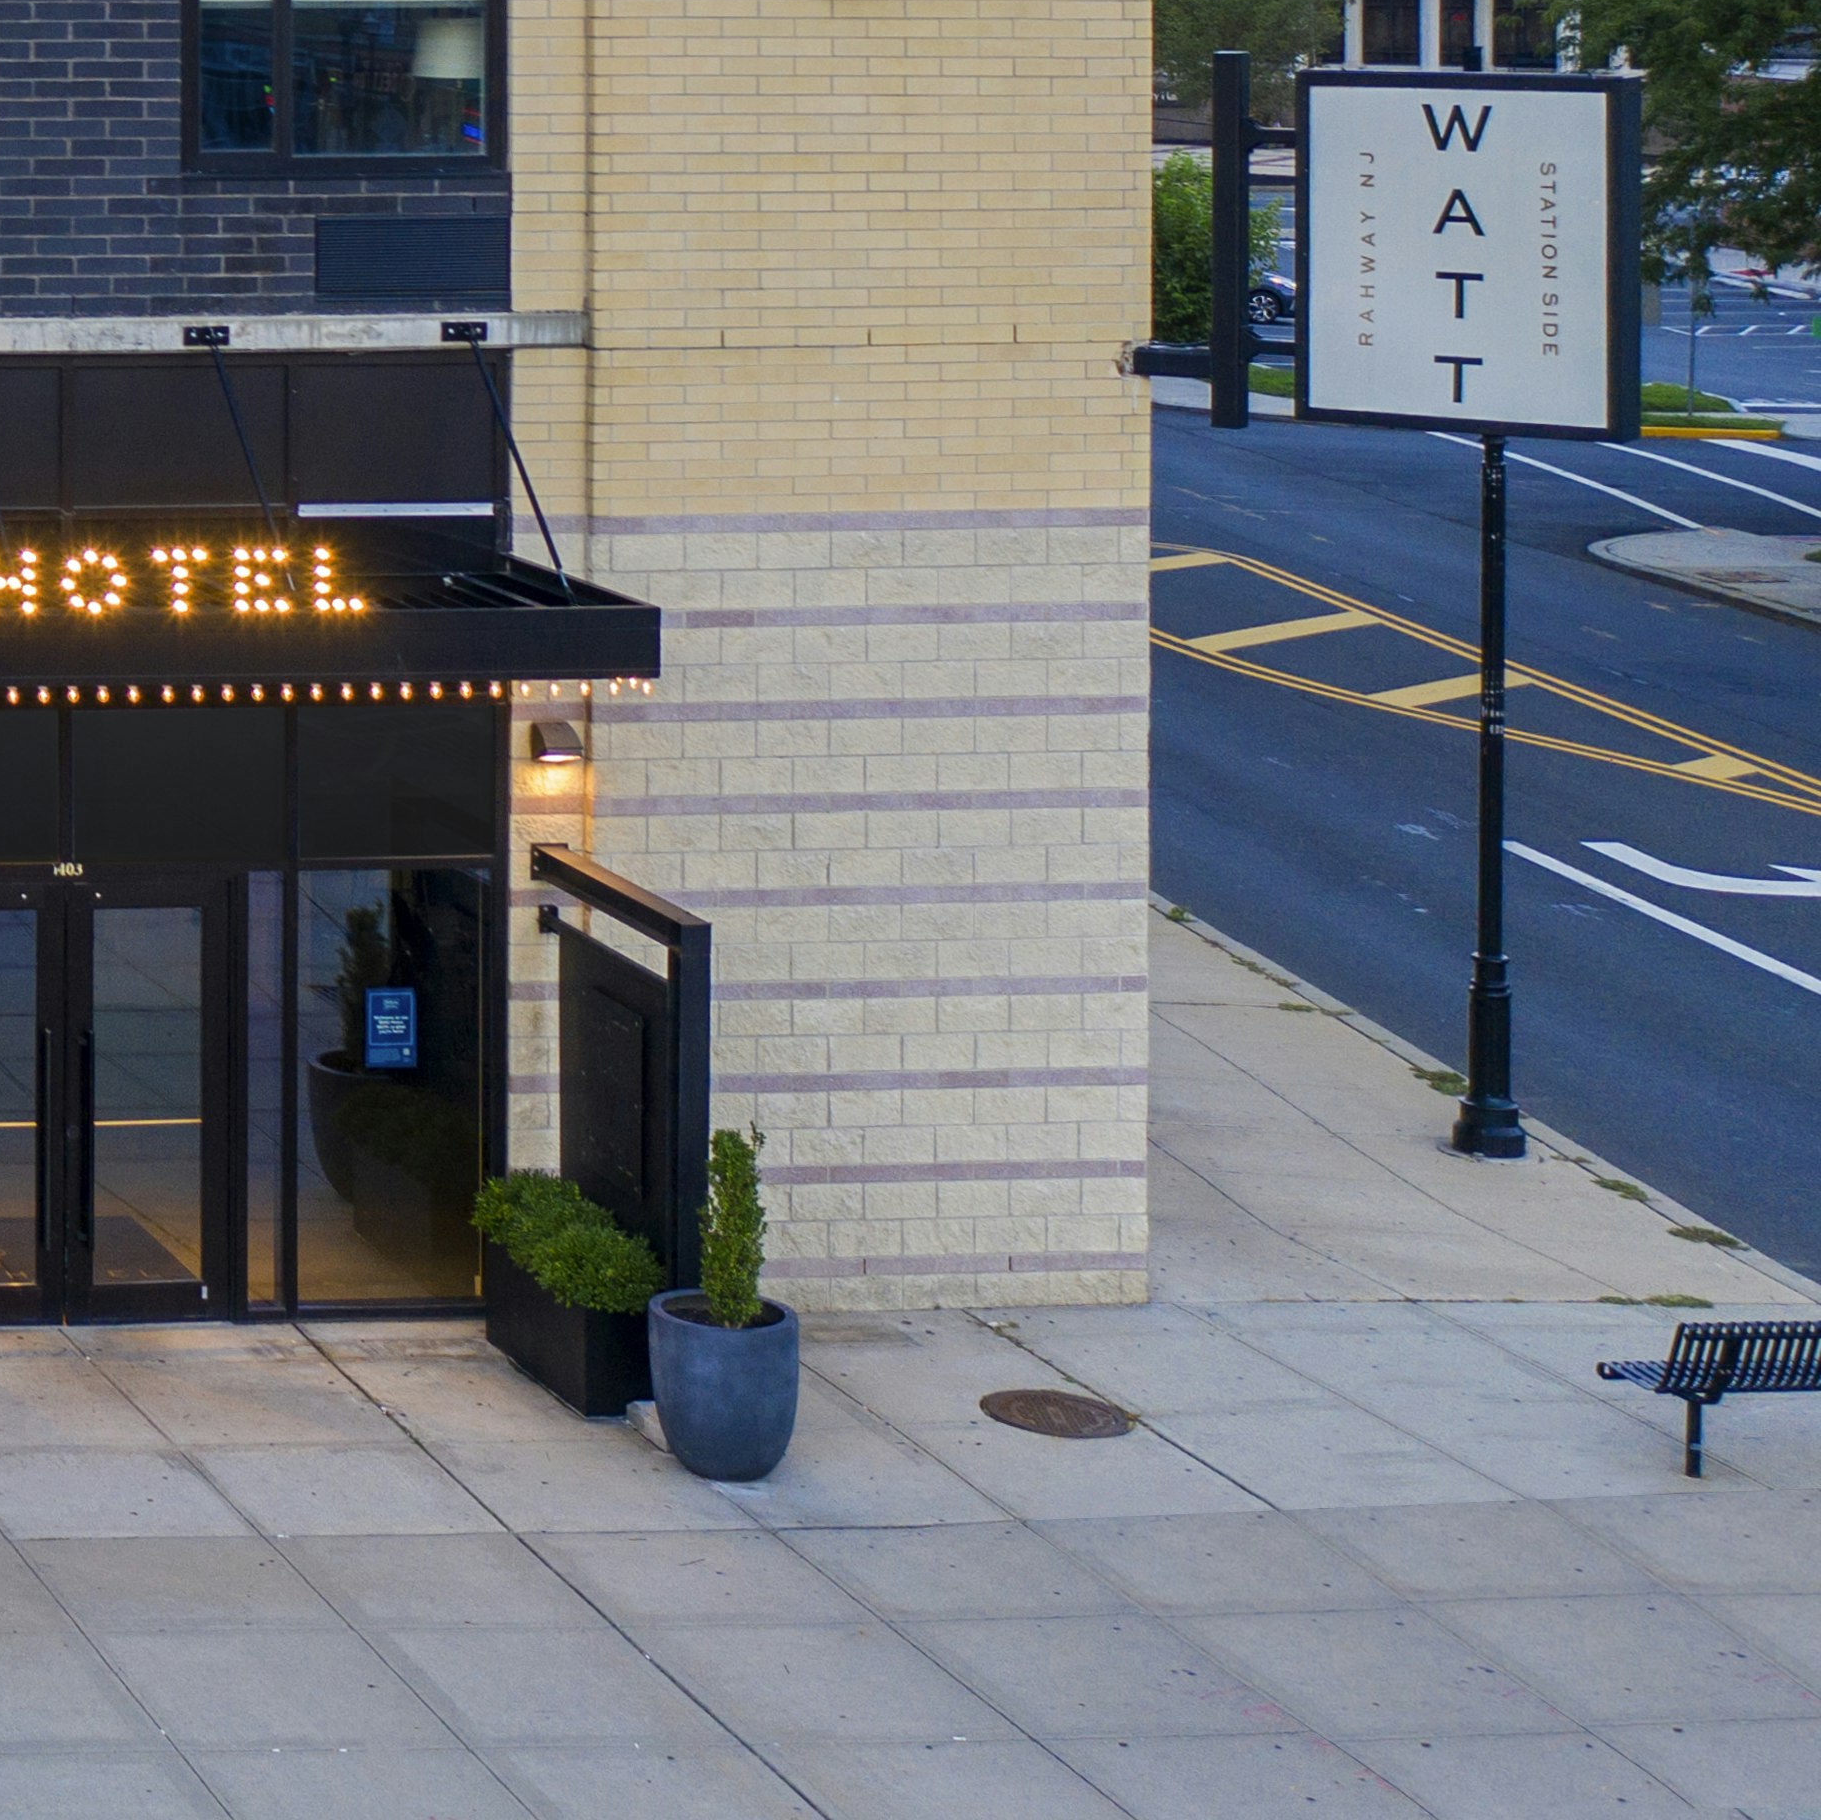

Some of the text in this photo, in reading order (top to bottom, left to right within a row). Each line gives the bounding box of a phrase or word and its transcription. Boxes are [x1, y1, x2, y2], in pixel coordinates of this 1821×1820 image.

[1358, 151, 1376, 347] RAHWAY NJ
[1421, 104, 1492, 404] WATT
[1539, 161, 1560, 357] STATION SIDE
